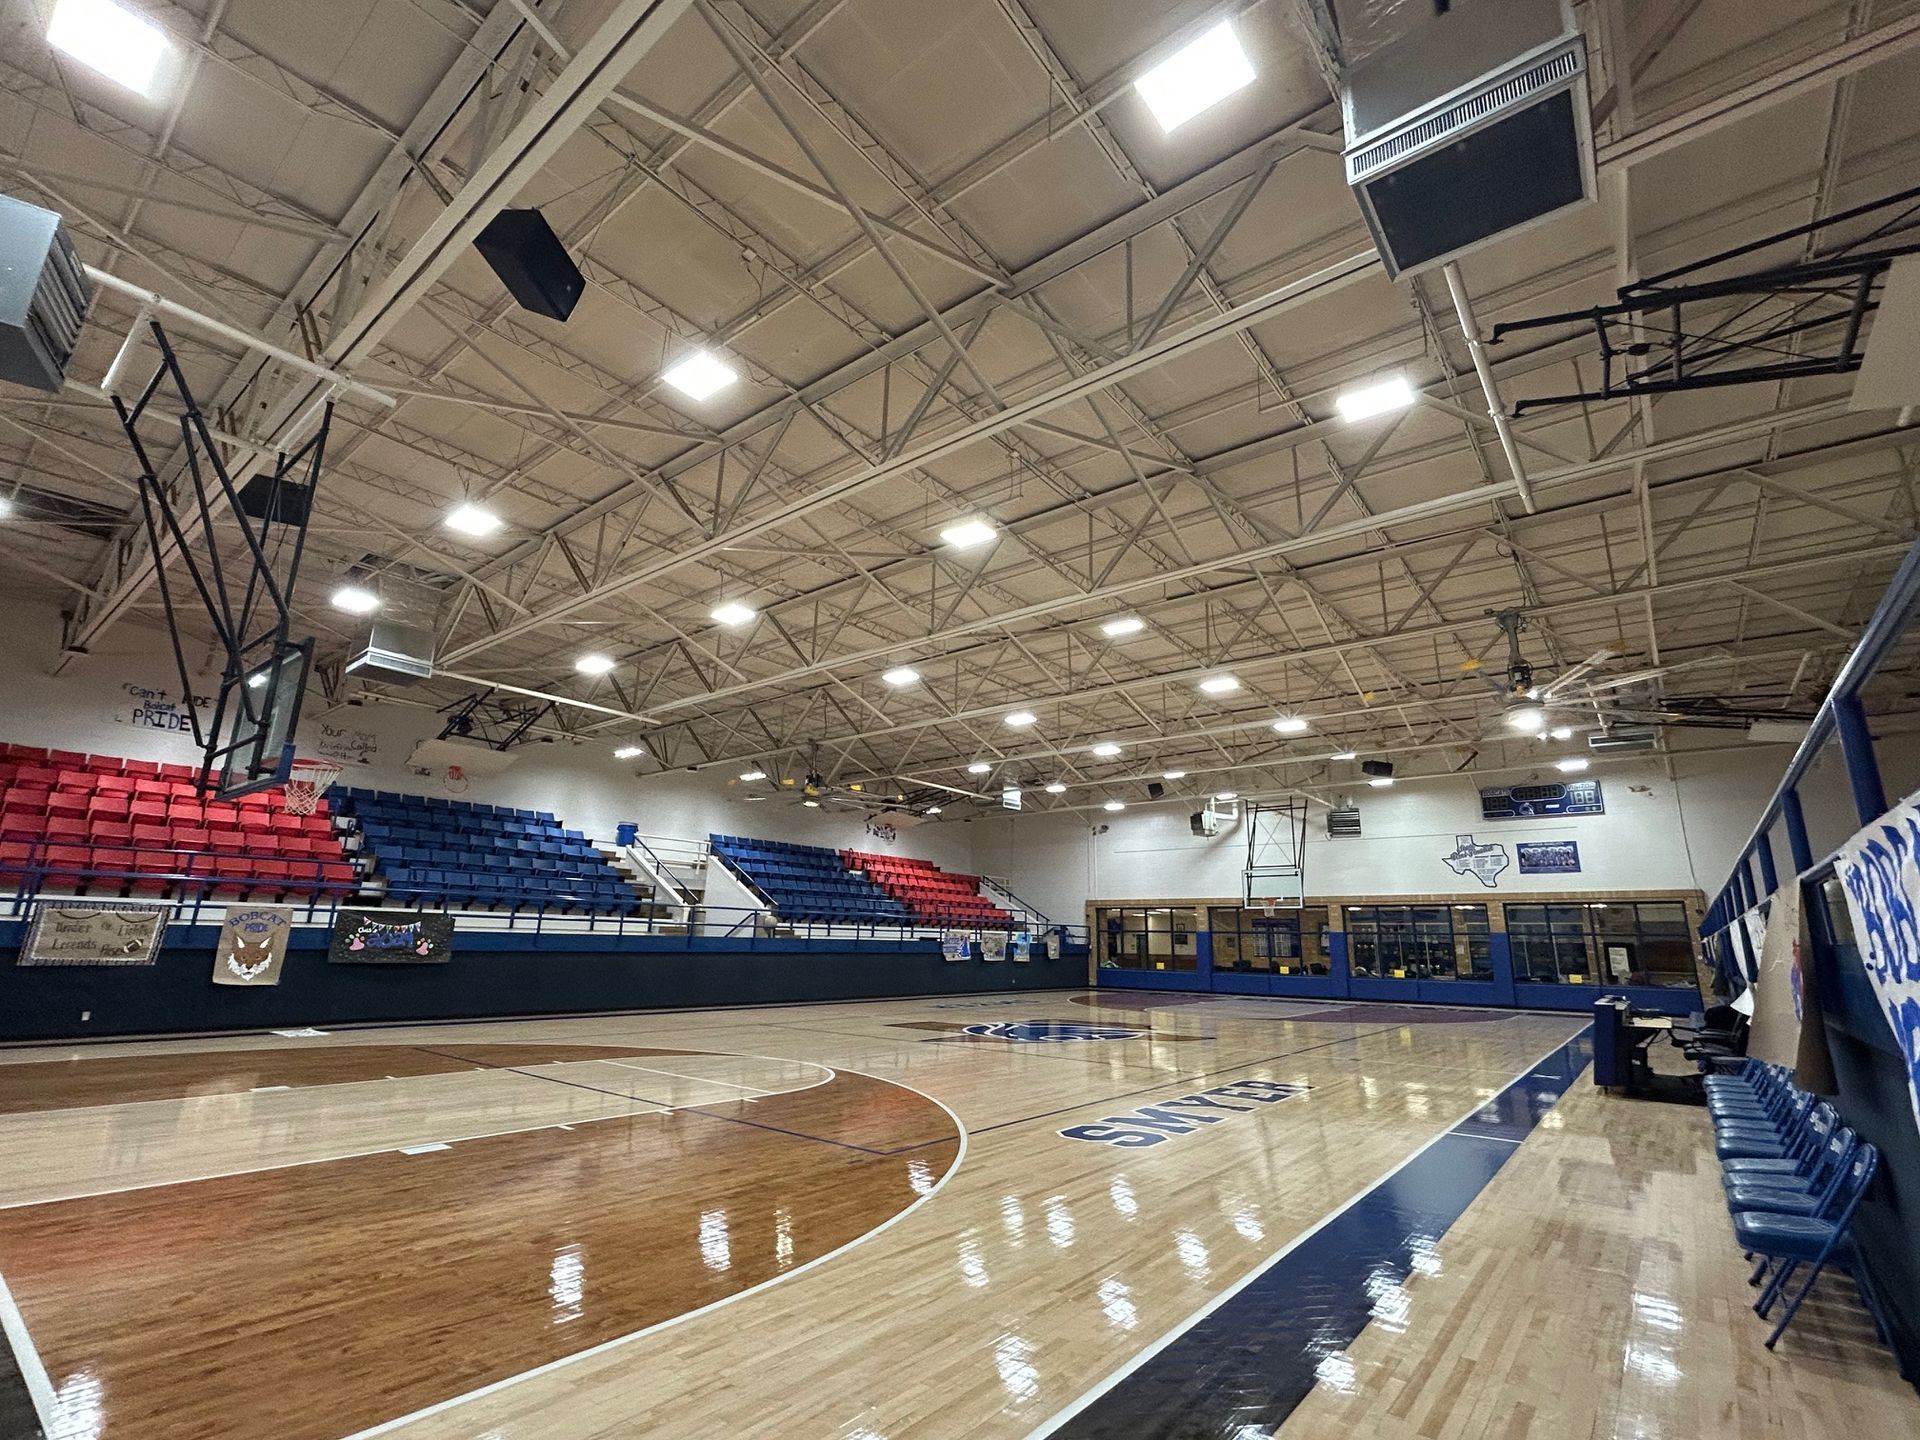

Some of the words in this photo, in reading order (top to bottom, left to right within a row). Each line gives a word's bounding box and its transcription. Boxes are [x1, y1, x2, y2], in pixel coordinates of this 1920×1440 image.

[132, 708, 191, 731] PRIDE
[228, 911, 287, 927] BOBCAT
[1056, 1079, 1317, 1148] SMYER
